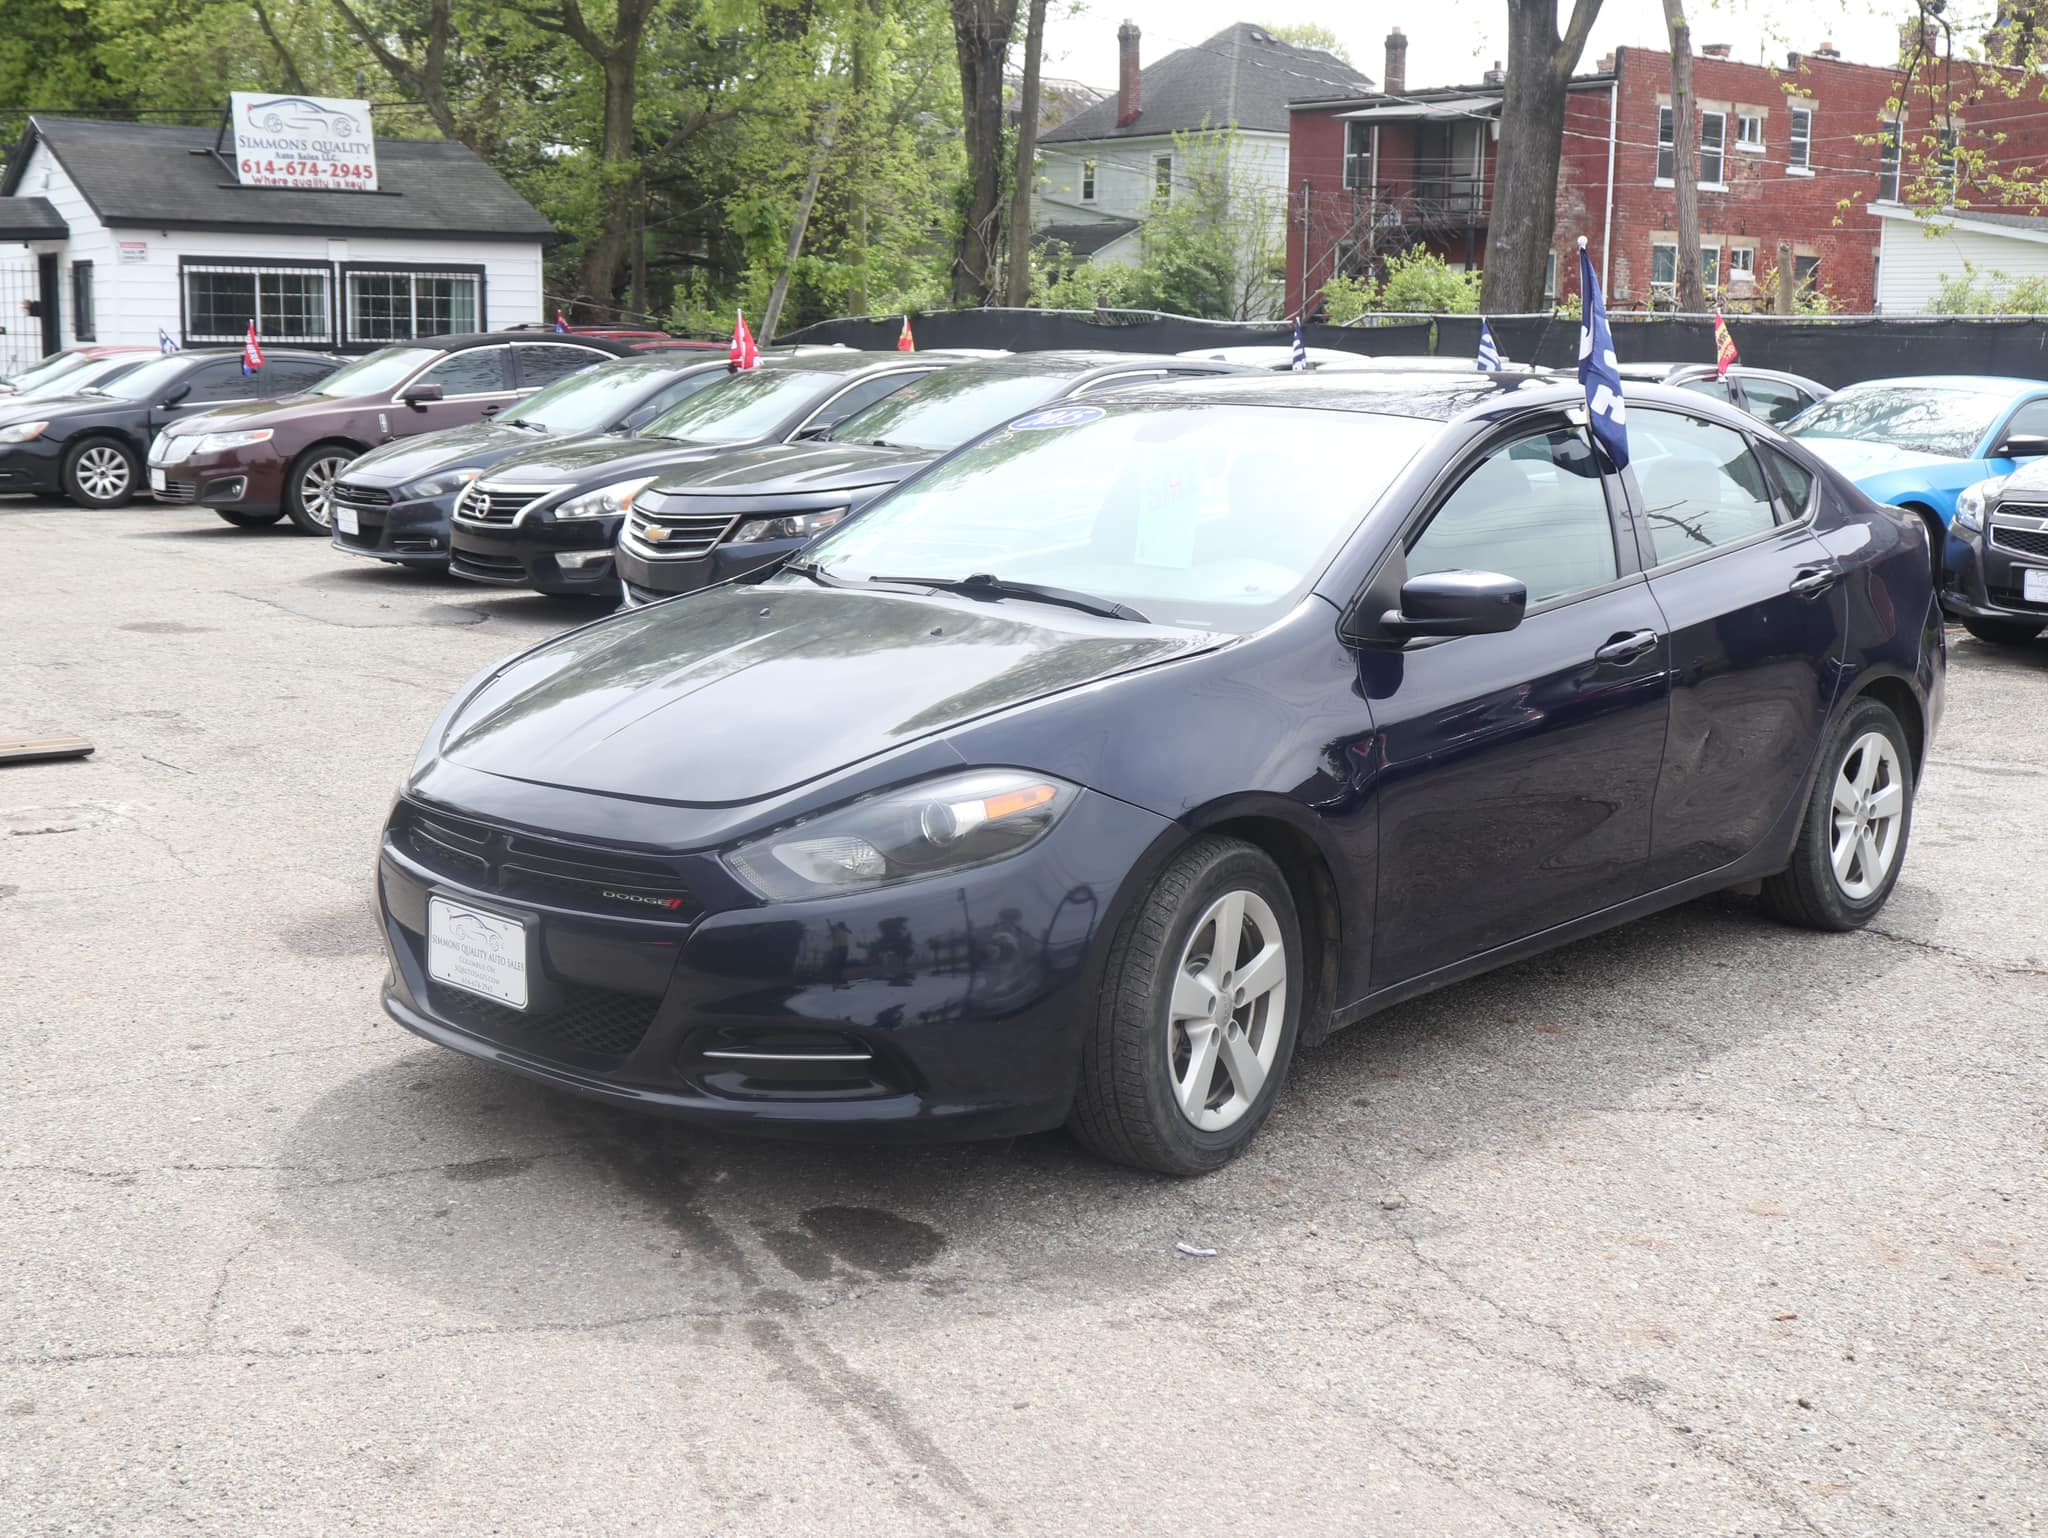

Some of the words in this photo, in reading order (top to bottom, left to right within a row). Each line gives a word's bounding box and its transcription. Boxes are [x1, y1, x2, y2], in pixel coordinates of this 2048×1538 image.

[239, 135, 308, 151] SIMMONS
[312, 140, 371, 155] QUALITY
[241, 158, 373, 179] 614-674-2945
[252, 175, 289, 186] Where
[292, 177, 329, 189] quality
[603, 890, 671, 906] DODGE
[432, 934, 461, 952] SIMMONS
[461, 943, 487, 961] QUALITY
[488, 952, 506, 966] AUTO
[507, 959, 525, 972] SALES
